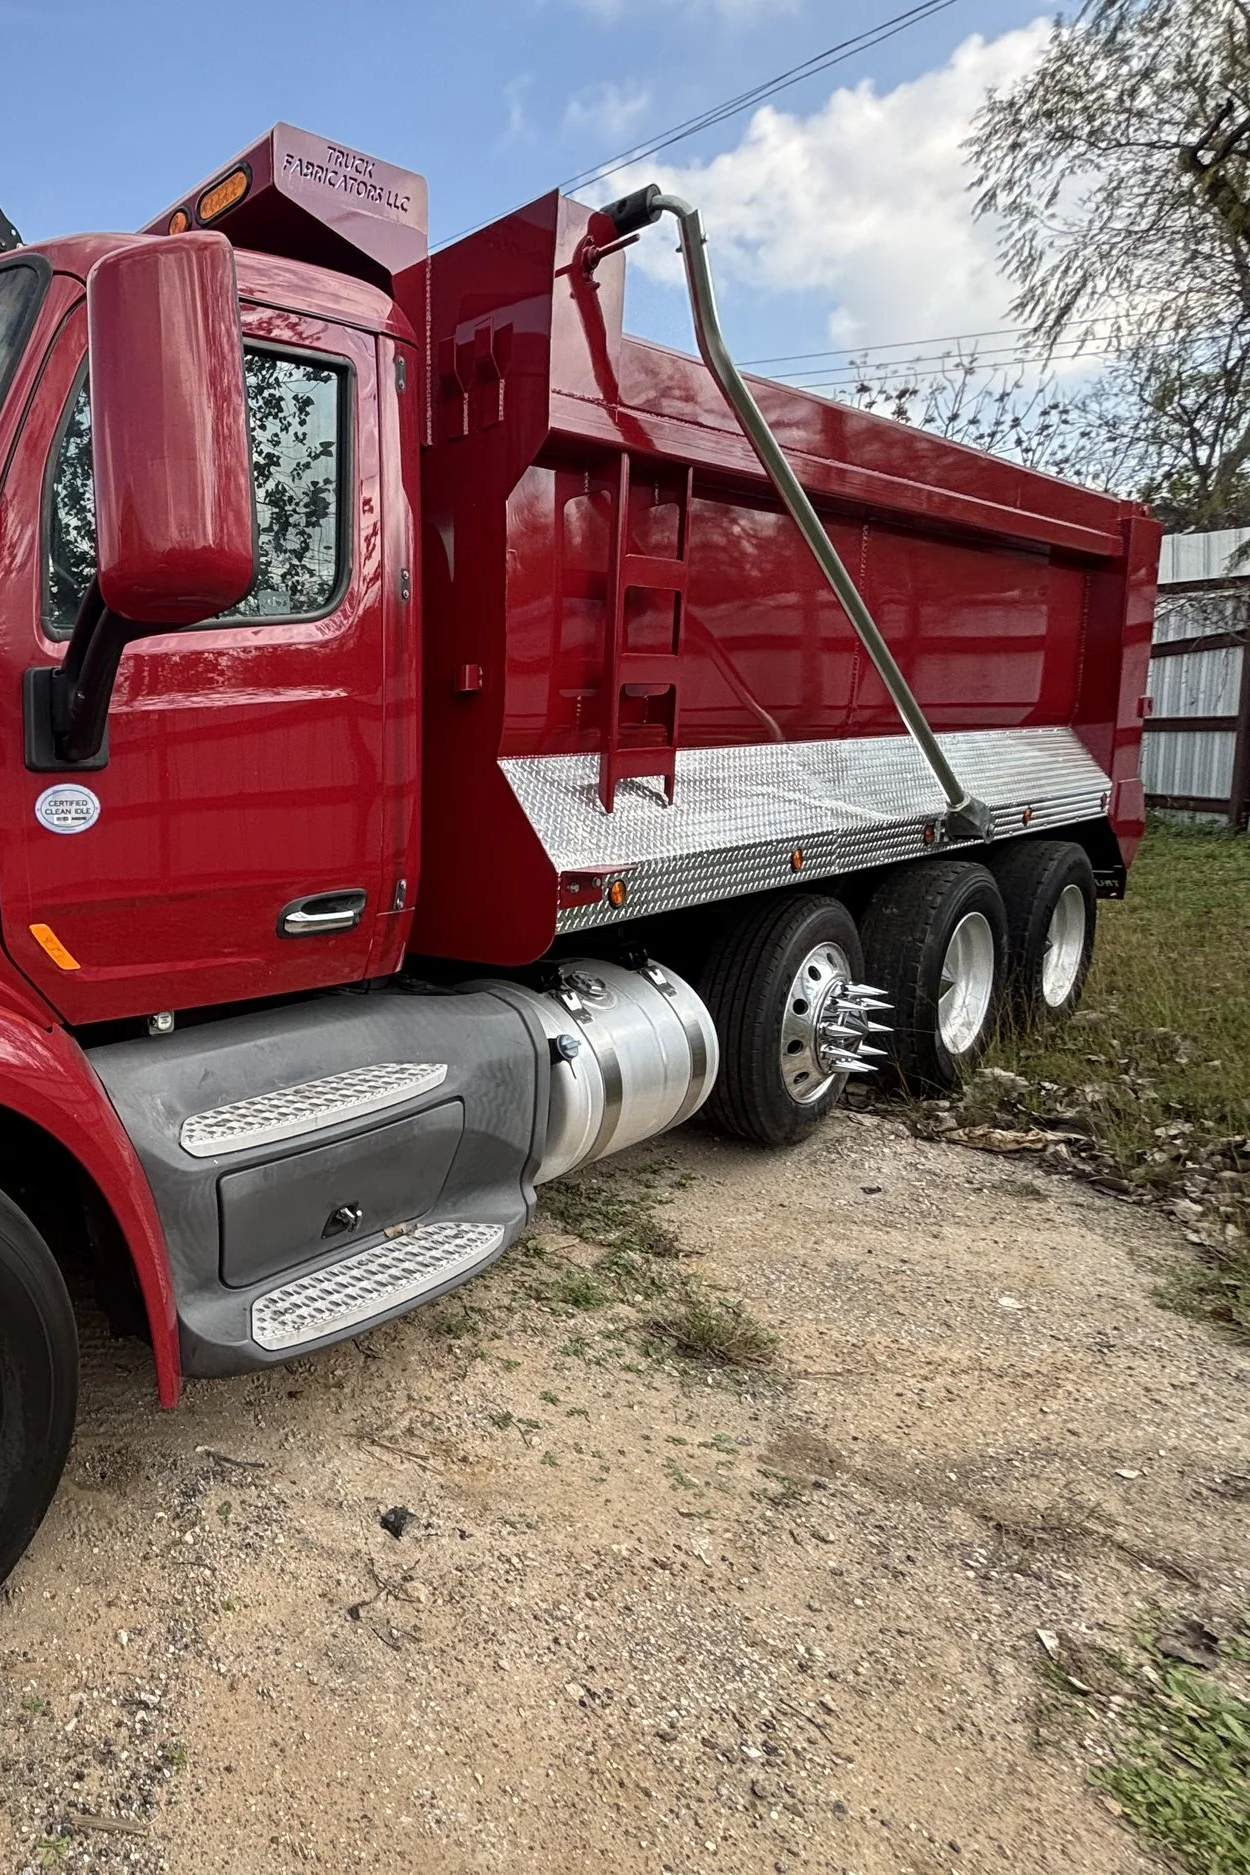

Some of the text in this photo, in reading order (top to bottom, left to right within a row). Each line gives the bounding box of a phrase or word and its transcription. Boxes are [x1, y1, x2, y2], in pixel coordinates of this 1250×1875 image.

[281, 153, 410, 213] FABRICATORS LLC
[327, 146, 375, 178] TRUCK
